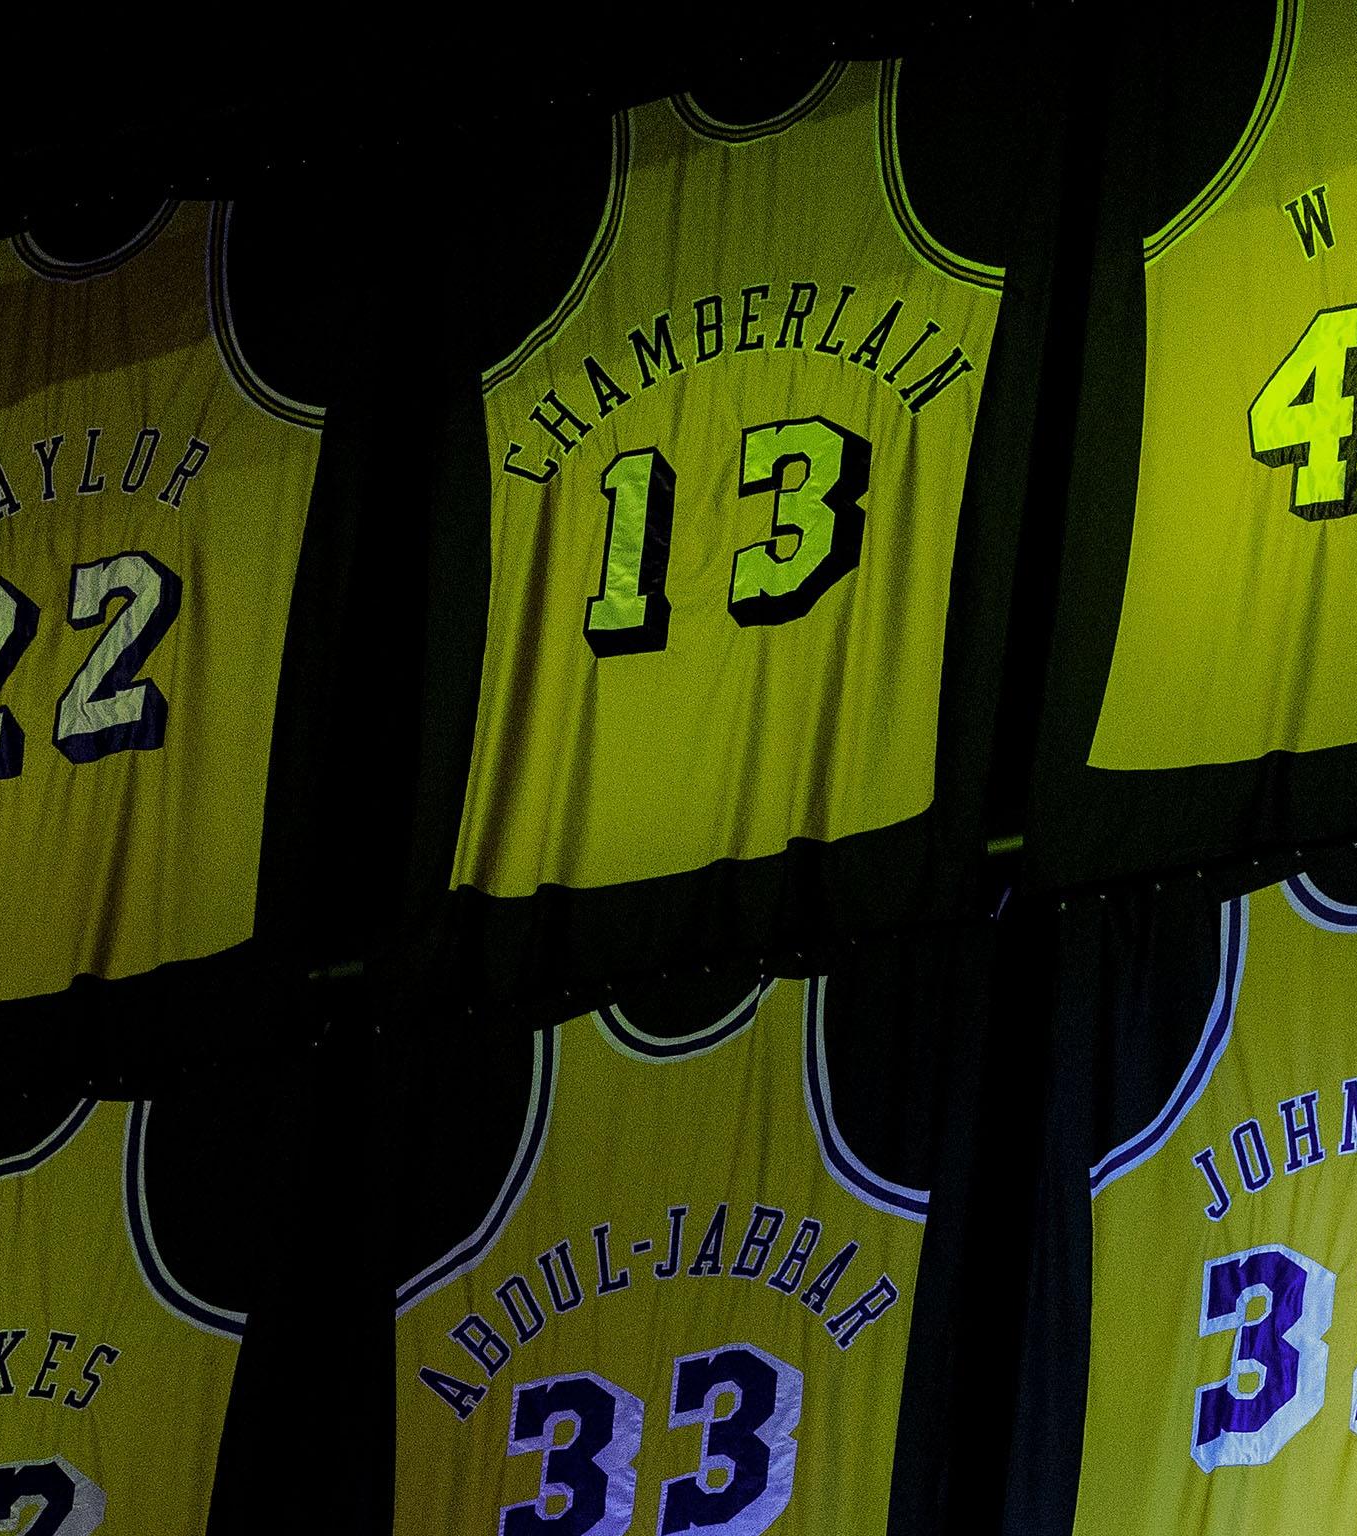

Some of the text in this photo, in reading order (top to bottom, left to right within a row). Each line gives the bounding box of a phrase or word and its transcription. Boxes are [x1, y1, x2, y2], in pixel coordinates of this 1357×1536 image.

[503, 282, 974, 484] CHAMBERLAIN
[583, 415, 872, 658] 13
[418, 1202, 900, 1422] ABDUL-JABBAR
